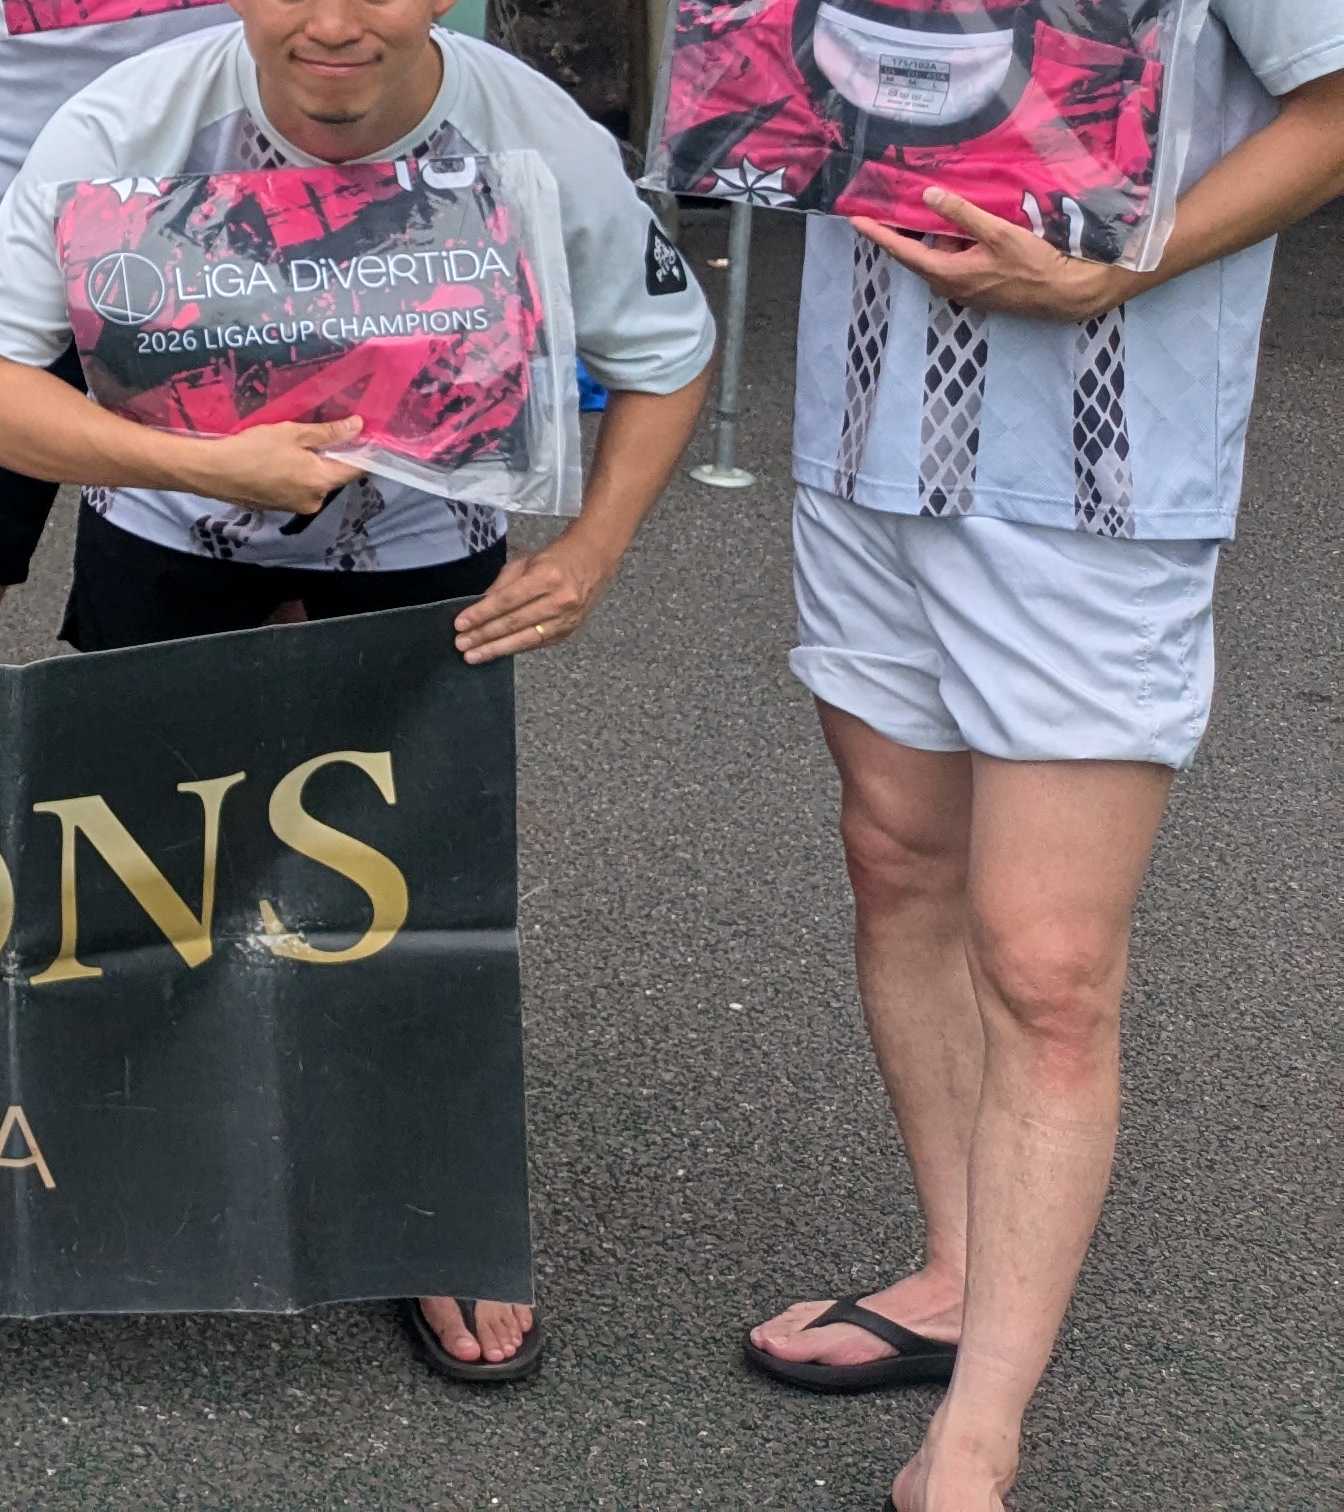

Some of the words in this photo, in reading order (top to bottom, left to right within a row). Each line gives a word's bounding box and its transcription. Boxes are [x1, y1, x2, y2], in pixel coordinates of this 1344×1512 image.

[136, 328, 198, 354] 2026
[203, 319, 314, 350] LIGACUP
[321, 307, 489, 339] CHAMPIONS
